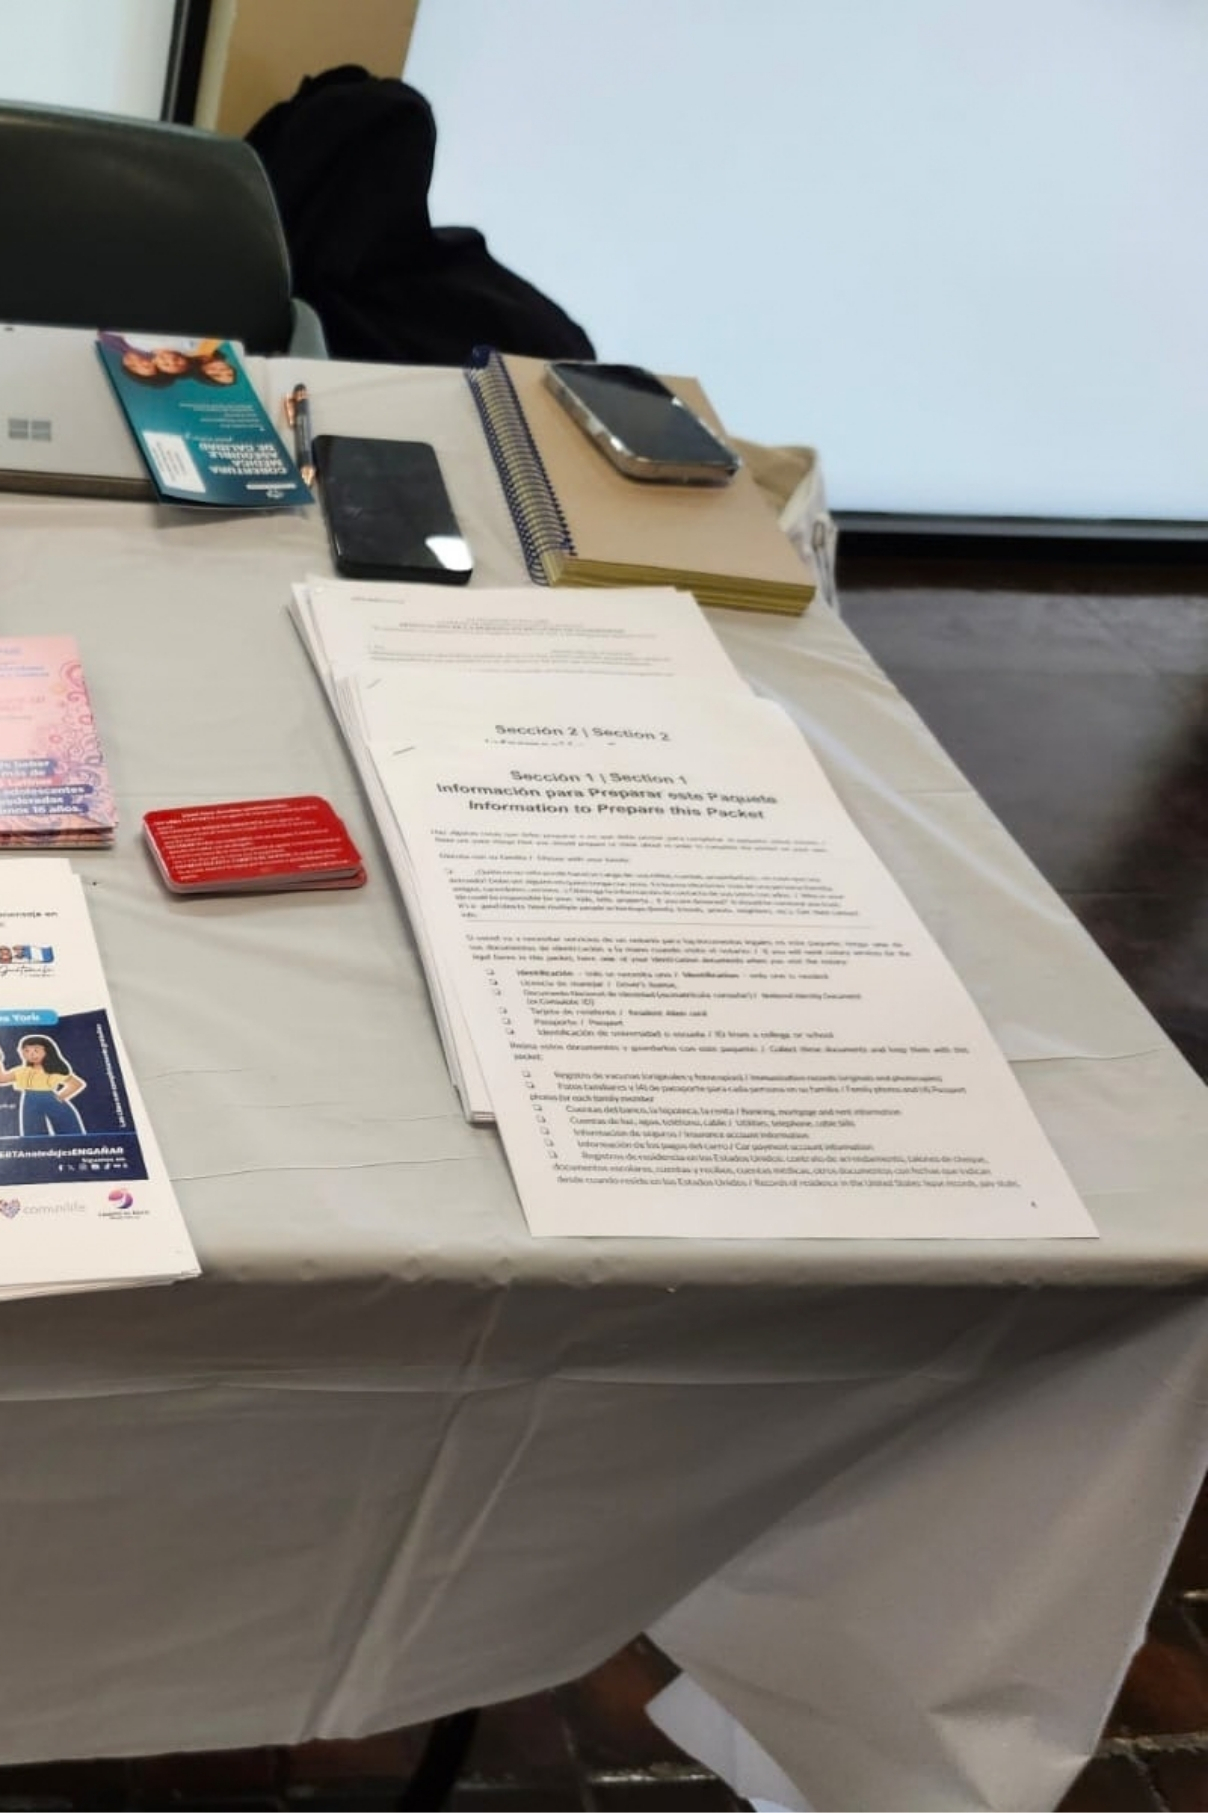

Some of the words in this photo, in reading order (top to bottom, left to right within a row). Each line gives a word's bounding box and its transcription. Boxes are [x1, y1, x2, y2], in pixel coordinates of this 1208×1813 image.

[495, 725, 564, 738] Sección
[568, 727, 579, 738] 2
[592, 727, 655, 741] Section
[658, 731, 671, 743] 2
[510, 769, 580, 784] Sección
[585, 772, 594, 784] 1
[610, 771, 674, 785] Section
[679, 775, 688, 786] 1
[437, 783, 541, 799] Información
[545, 788, 584, 801] para
[588, 787, 663, 802] Preparar
[668, 791, 704, 802] este
[707, 791, 779, 807] Paquete
[469, 800, 570, 815] Information
[574, 803, 592, 815] to
[596, 804, 666, 819] Prepare
[670, 804, 702, 817] this
[706, 806, 766, 820] Packet
[12, 1012, 41, 1023] York
